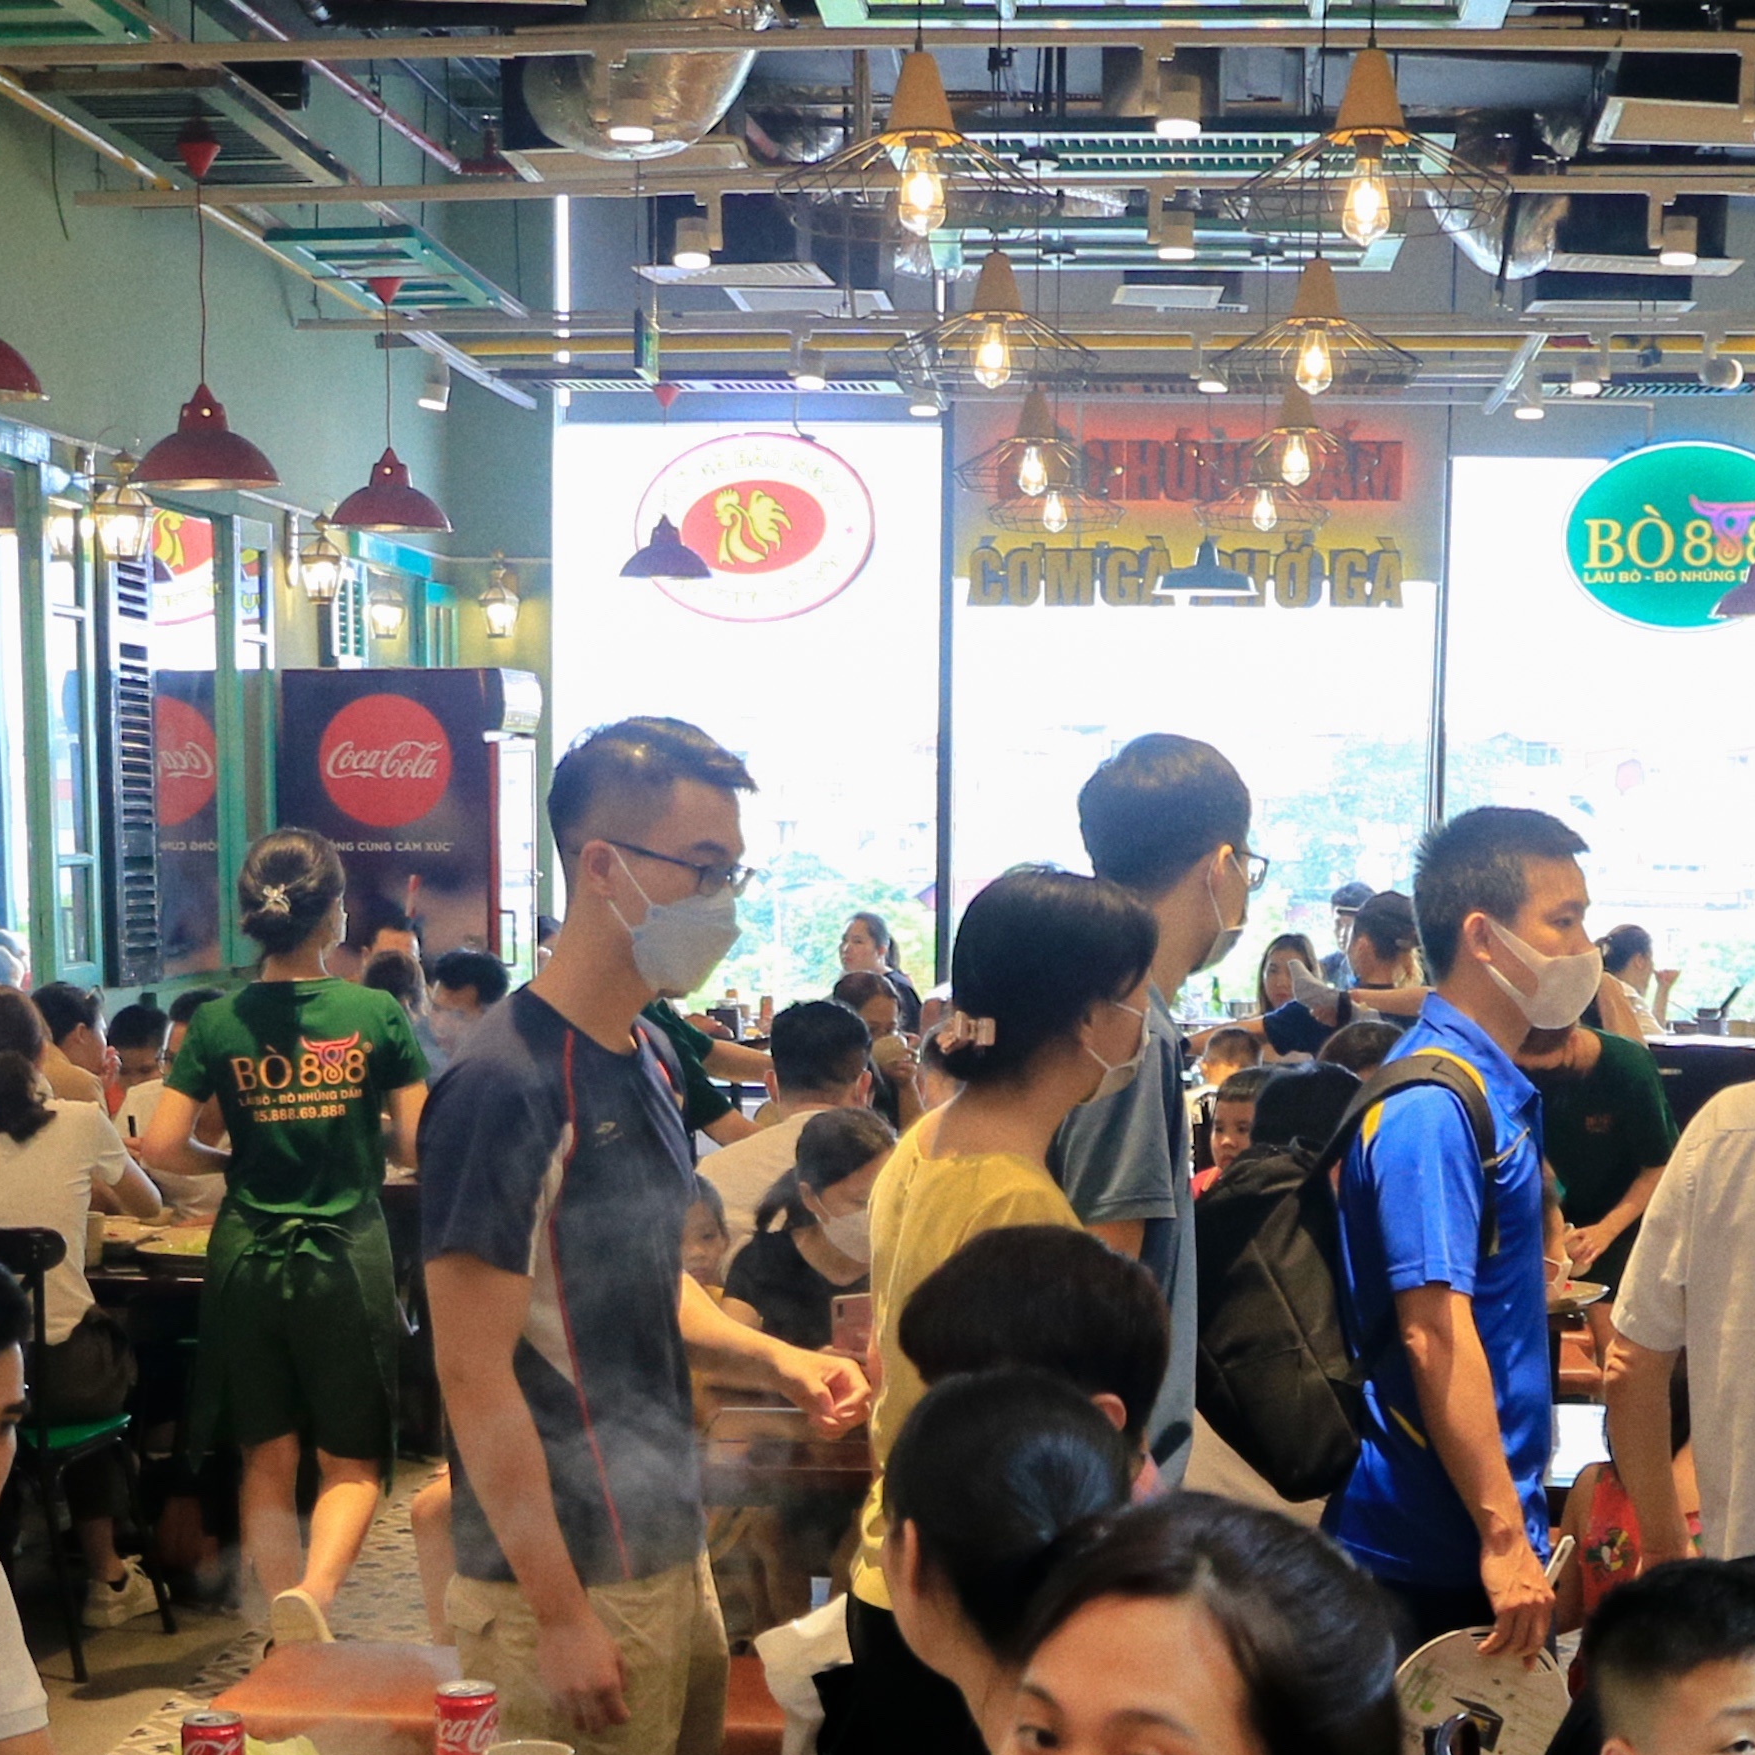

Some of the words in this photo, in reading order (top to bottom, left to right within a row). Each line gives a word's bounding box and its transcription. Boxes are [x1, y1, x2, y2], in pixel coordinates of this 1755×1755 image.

[1583, 504, 1675, 569] BÒ
[326, 740, 443, 780] Coca-Cola
[229, 1044, 294, 1093] BÒ
